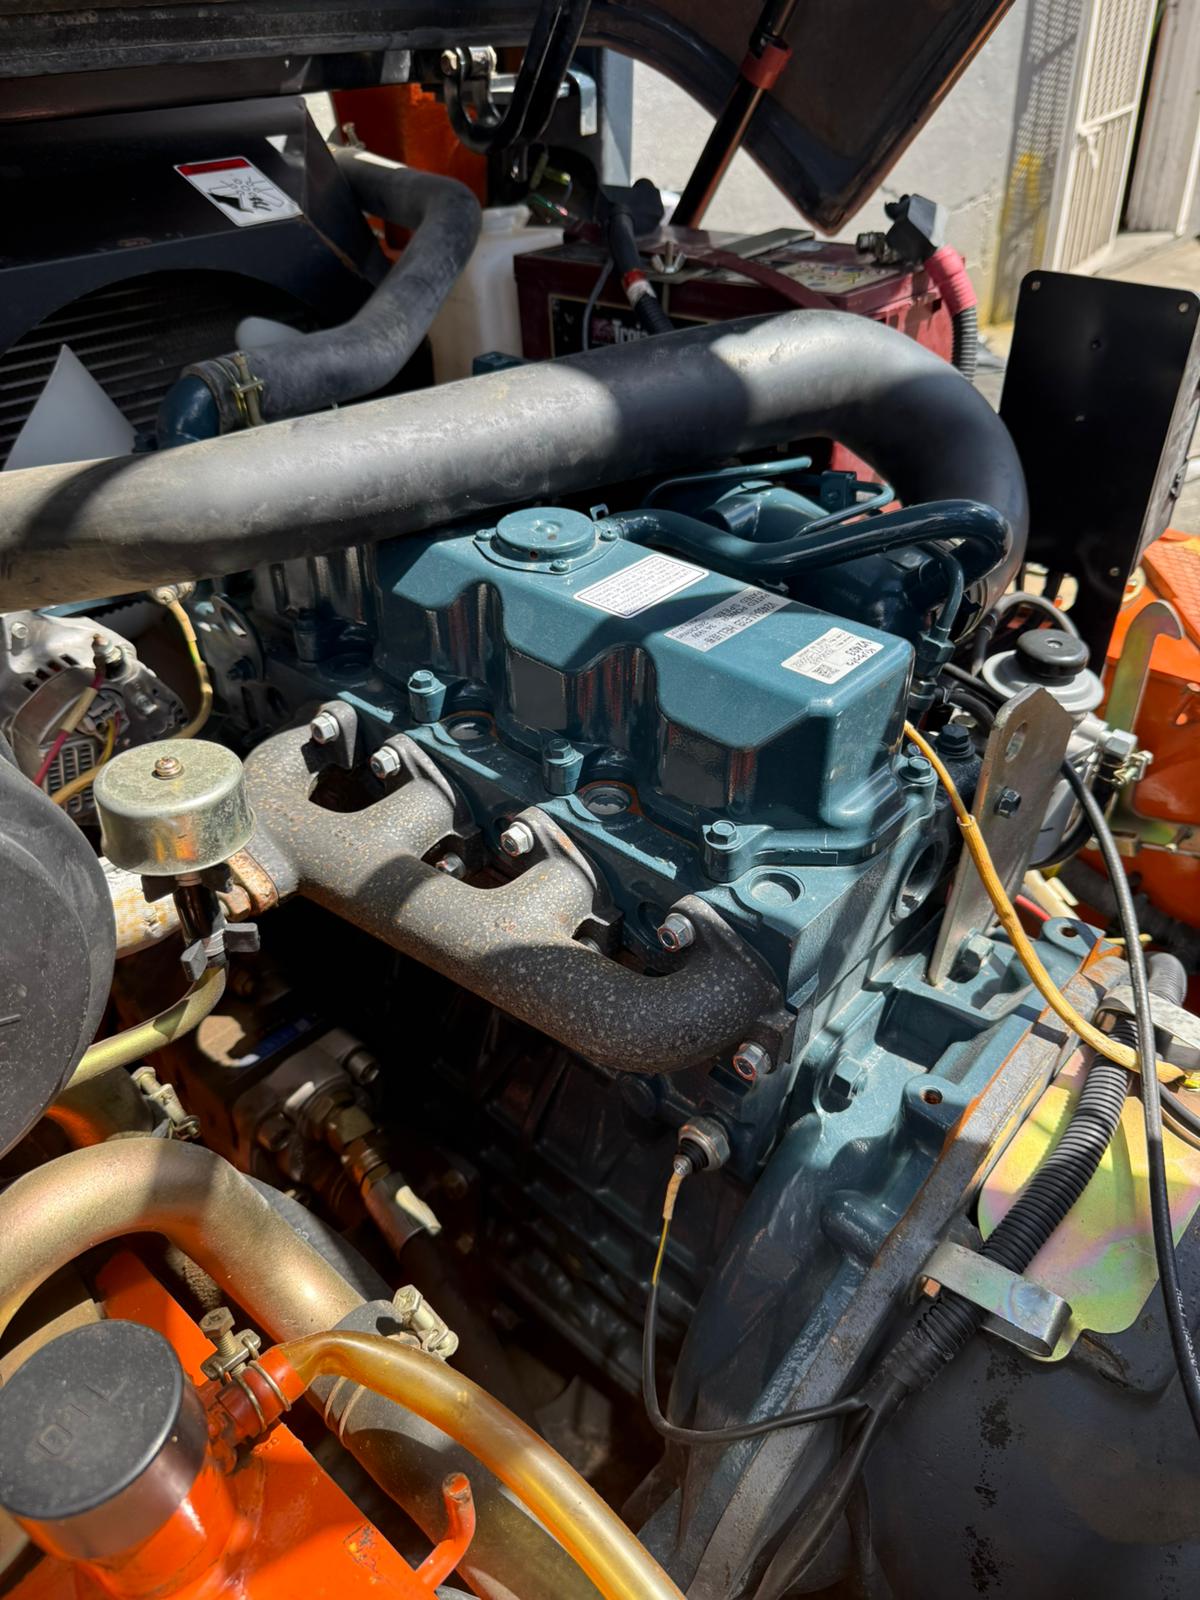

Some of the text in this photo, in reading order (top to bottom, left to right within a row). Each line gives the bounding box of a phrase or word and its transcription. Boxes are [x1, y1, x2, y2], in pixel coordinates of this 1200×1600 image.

[739, 591, 762, 604] RATED
[746, 593, 770, 607] RATED
[844, 640, 872, 656] V2403
[36, 1377, 128, 1456] OIL
